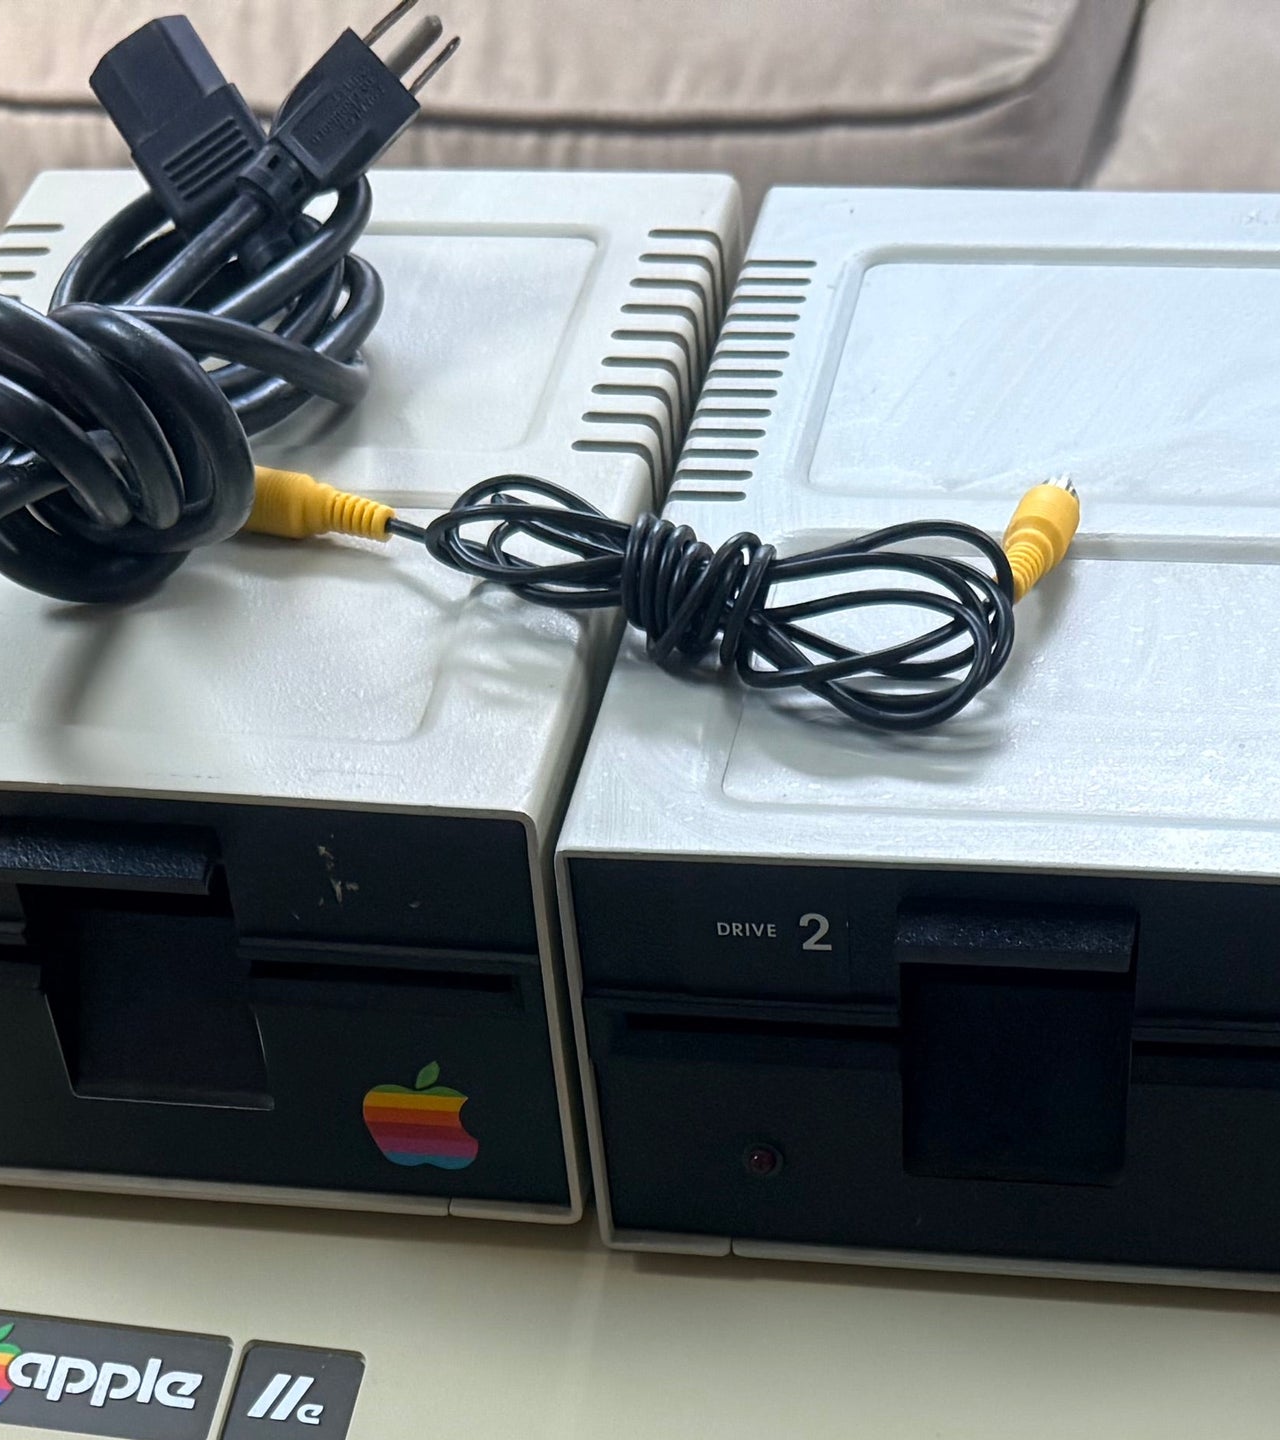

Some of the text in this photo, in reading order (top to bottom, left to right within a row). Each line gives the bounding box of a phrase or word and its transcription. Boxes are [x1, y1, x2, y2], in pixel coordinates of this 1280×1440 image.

[716, 912, 832, 951] DRIVE 2
[7, 1352, 204, 1410] apple
